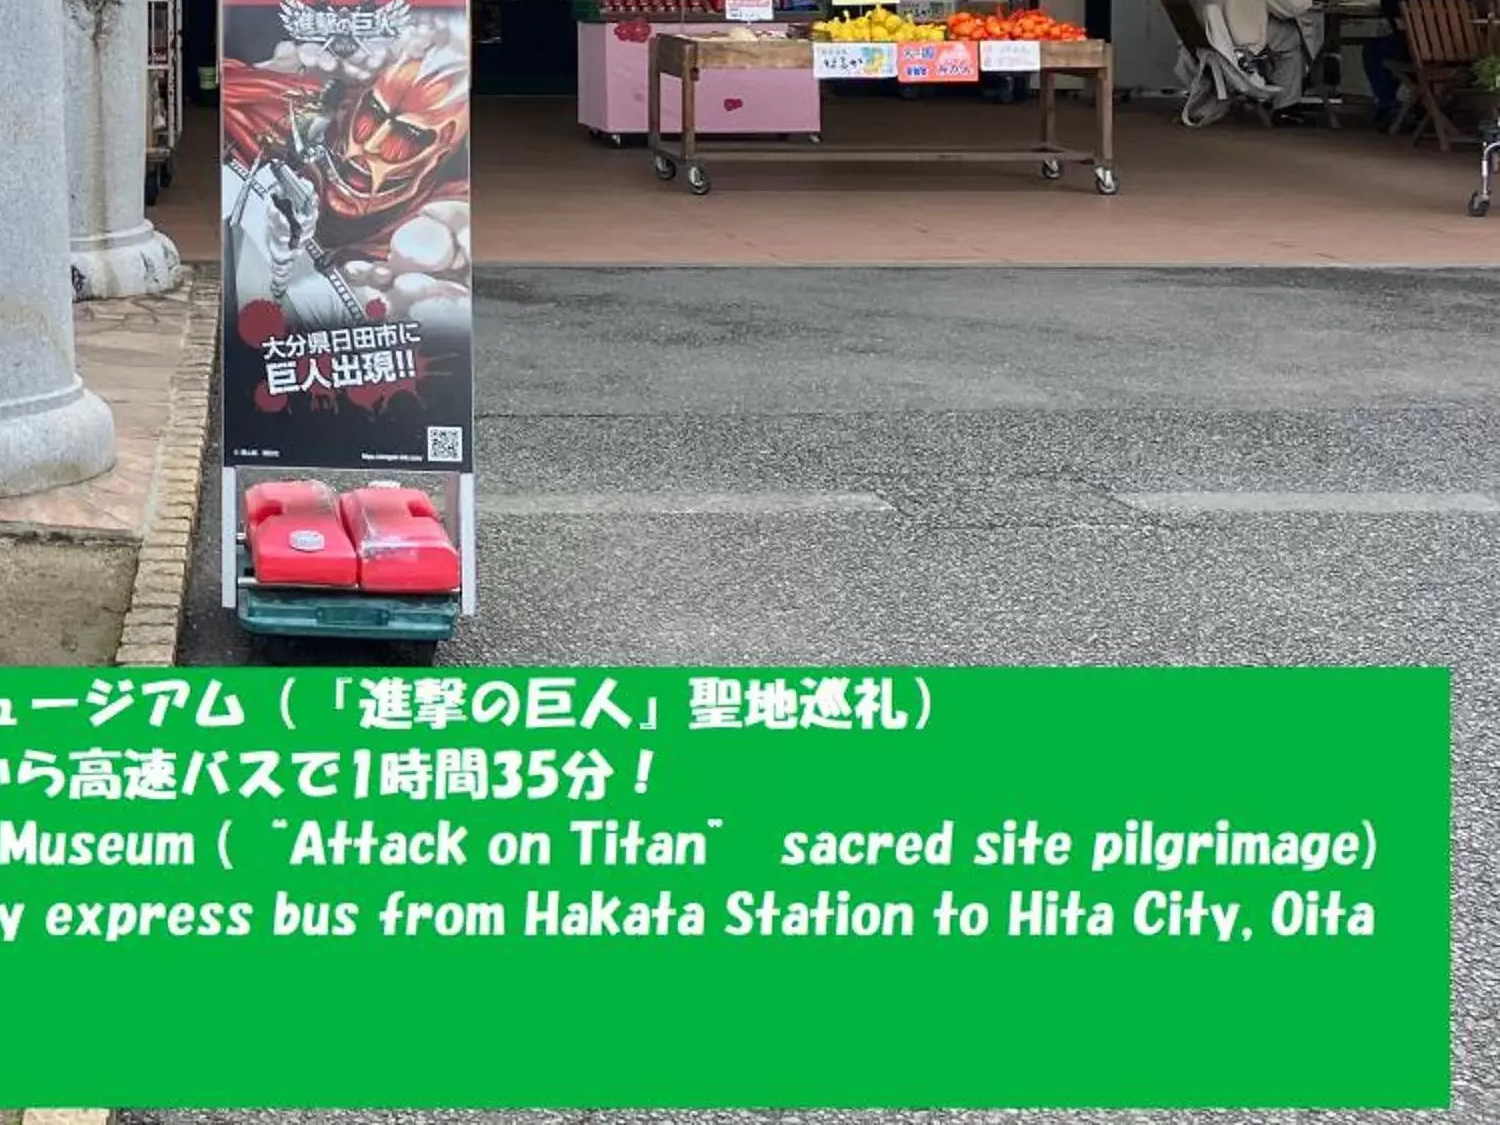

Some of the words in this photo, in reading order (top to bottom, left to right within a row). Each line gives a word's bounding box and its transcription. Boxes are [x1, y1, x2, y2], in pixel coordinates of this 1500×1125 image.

[261, 322, 421, 361] 大分県日田市に
